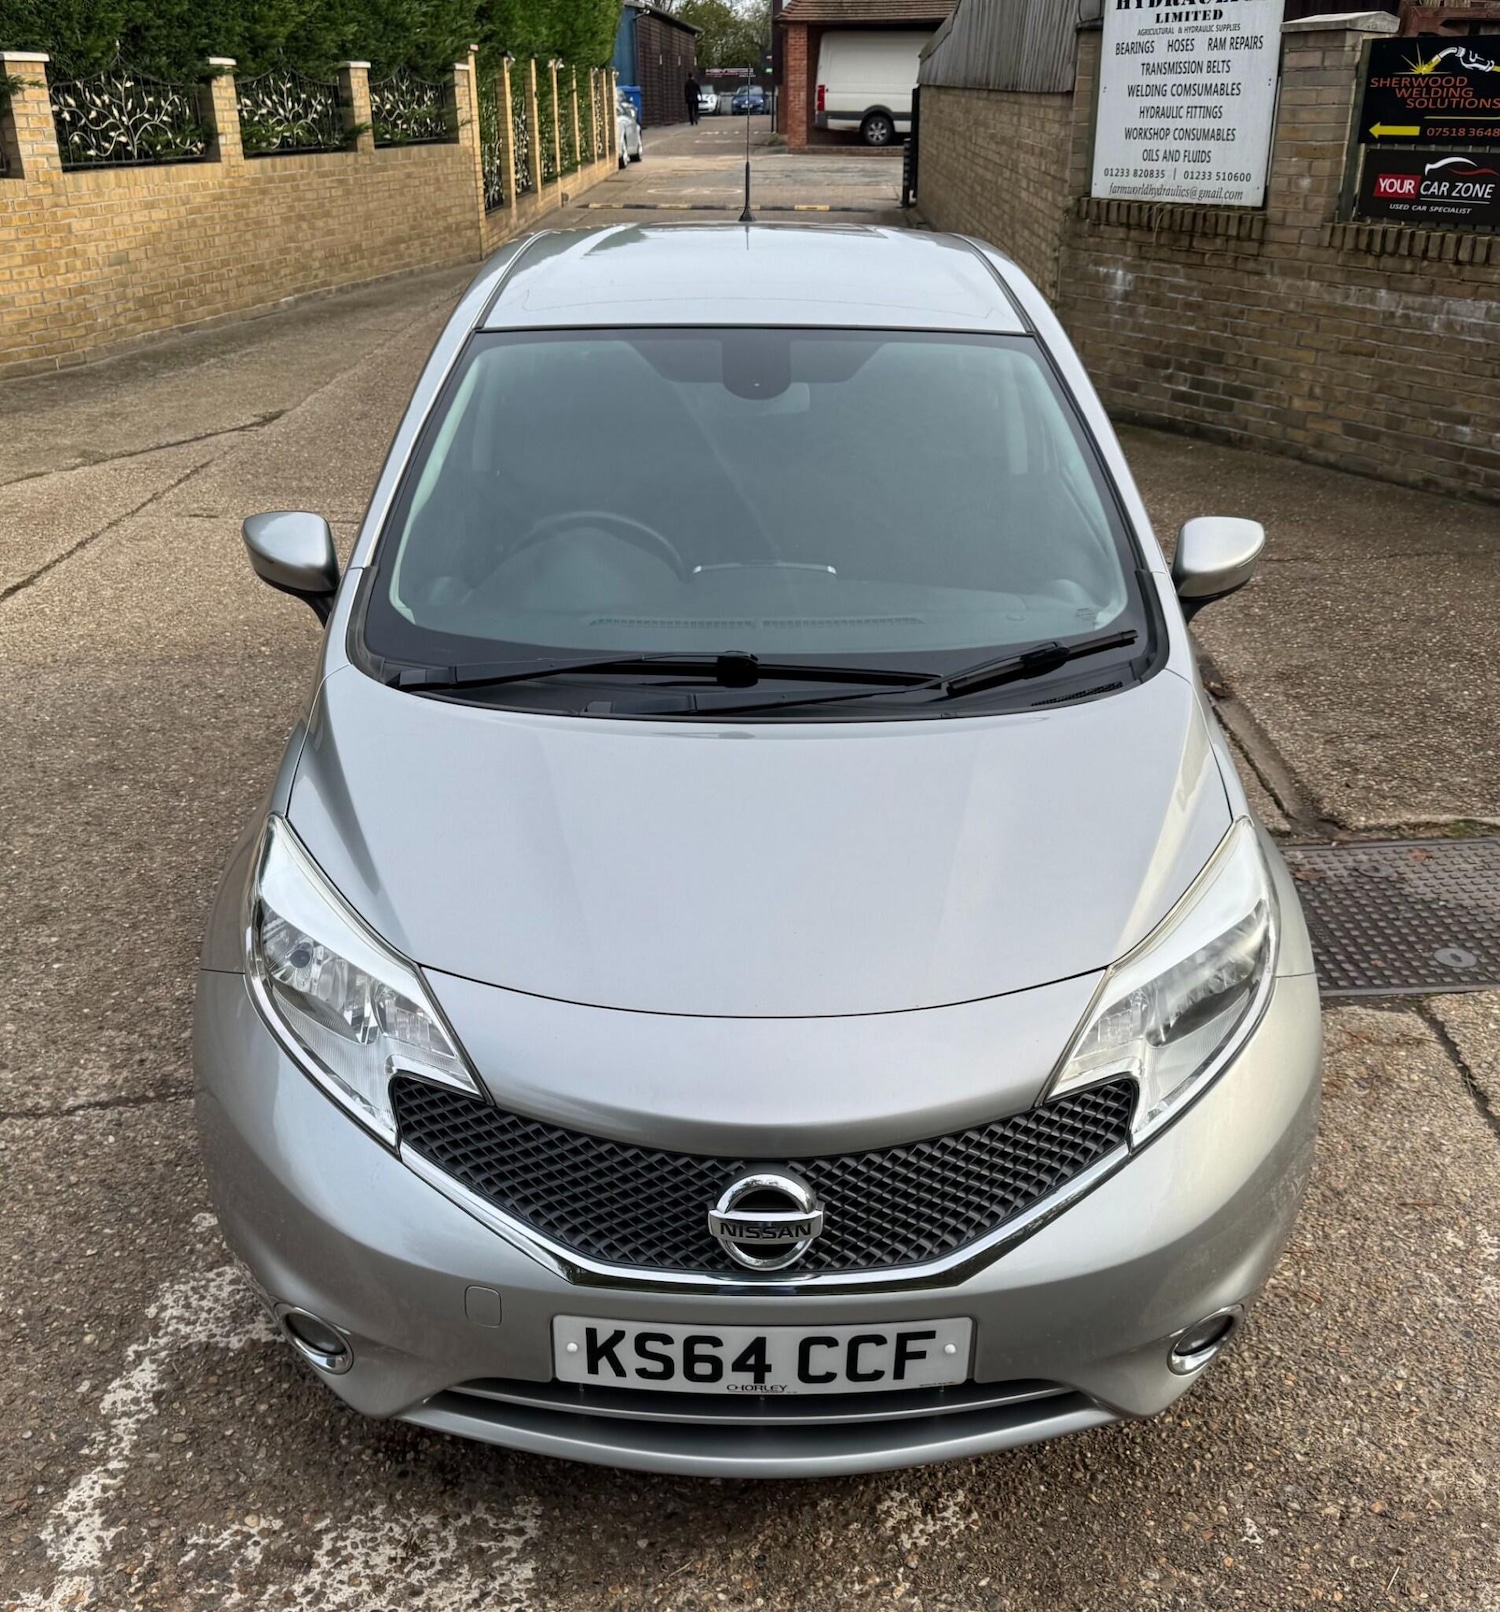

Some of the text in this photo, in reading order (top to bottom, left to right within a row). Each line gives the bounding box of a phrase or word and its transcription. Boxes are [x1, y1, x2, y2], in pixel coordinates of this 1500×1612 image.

[1155, 9, 1223, 24] LIMITED
[1137, 27, 1174, 36] AGRICULTURAL
[1184, 25, 1214, 33] HYDRAULIC
[1216, 23, 1240, 32] SUPPLIES
[1115, 35, 1264, 55] BEARINGS HOSES RAM REPAIRS
[1141, 60, 1231, 76] TRANSMISSION BELTS
[1370, 76, 1468, 88] SHERWOOD
[1127, 84, 1167, 97] WELDING
[1395, 87, 1474, 98] WELDING
[1406, 98, 1500, 109] SOLUTIONS
[1139, 105, 1223, 119] HYDRAULIC FITTINGS
[1124, 127, 1236, 142] WORKSHOP CONSUMABLES
[1426, 127, 1466, 136] 07518
[1142, 149, 1211, 163] OILS AND FLUIDS
[1104, 168, 1251, 182] 01233 820835 01233 510600
[1109, 182, 1243, 200] farmworldhydraulics@gmail.com
[1379, 178, 1495, 198] YOUR CAR ZONE
[1389, 203, 1409, 211] USED
[1429, 205, 1472, 214] SPECIALIST
[720, 1222, 812, 1240] NISSAN
[585, 1327, 937, 1385] KS64 CCF
